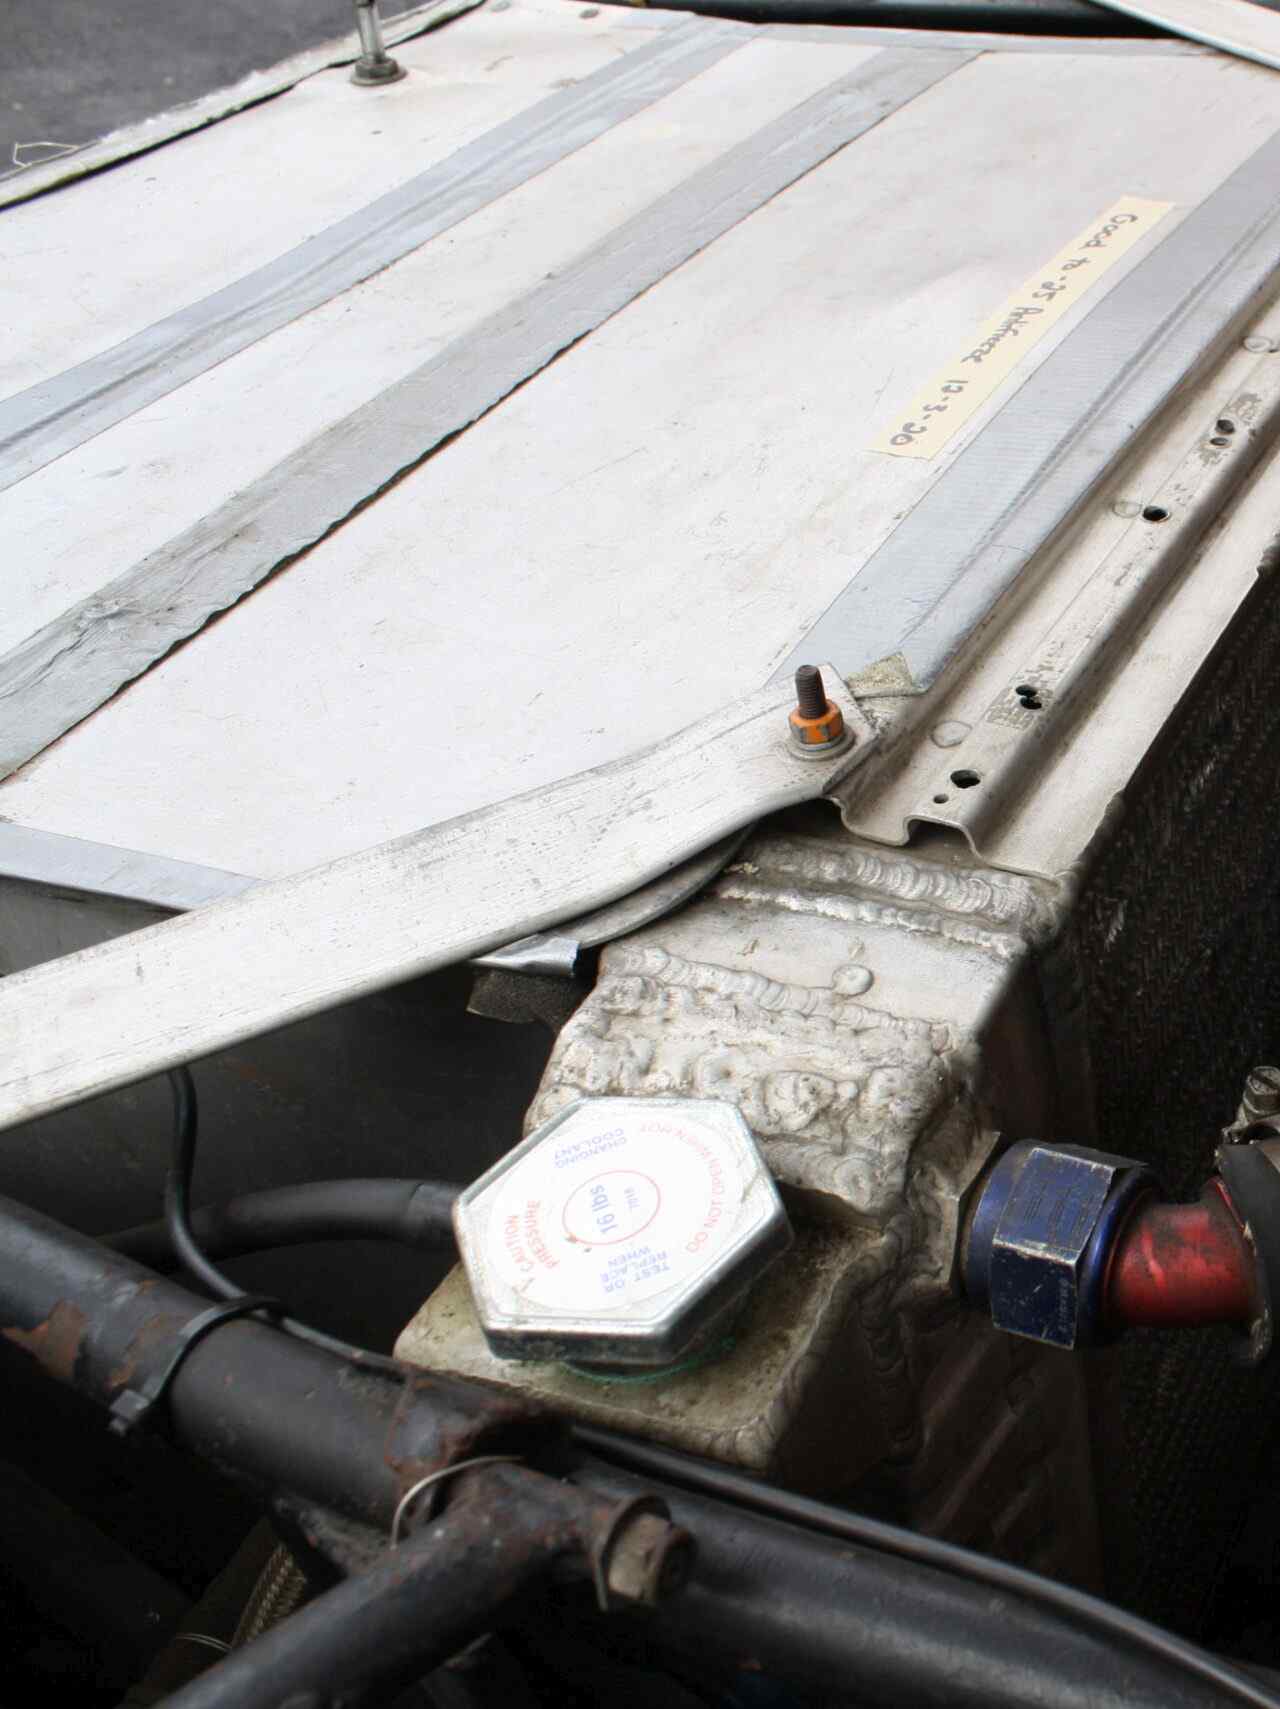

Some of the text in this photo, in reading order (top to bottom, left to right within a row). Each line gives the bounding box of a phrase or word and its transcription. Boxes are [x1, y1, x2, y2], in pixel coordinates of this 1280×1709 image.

[1080, 213, 1138, 250] Good
[553, 1127, 625, 1161] COOLANT
[554, 1136, 628, 1170] CHANGING
[589, 1184, 618, 1234] 16 lbs
[503, 1214, 535, 1273] CAUTION
[524, 1200, 560, 1270] PRESSURE
[600, 1250, 669, 1283] REPLACE
[606, 1246, 652, 1267] WHEN
[602, 1262, 672, 1294] TEST OR
